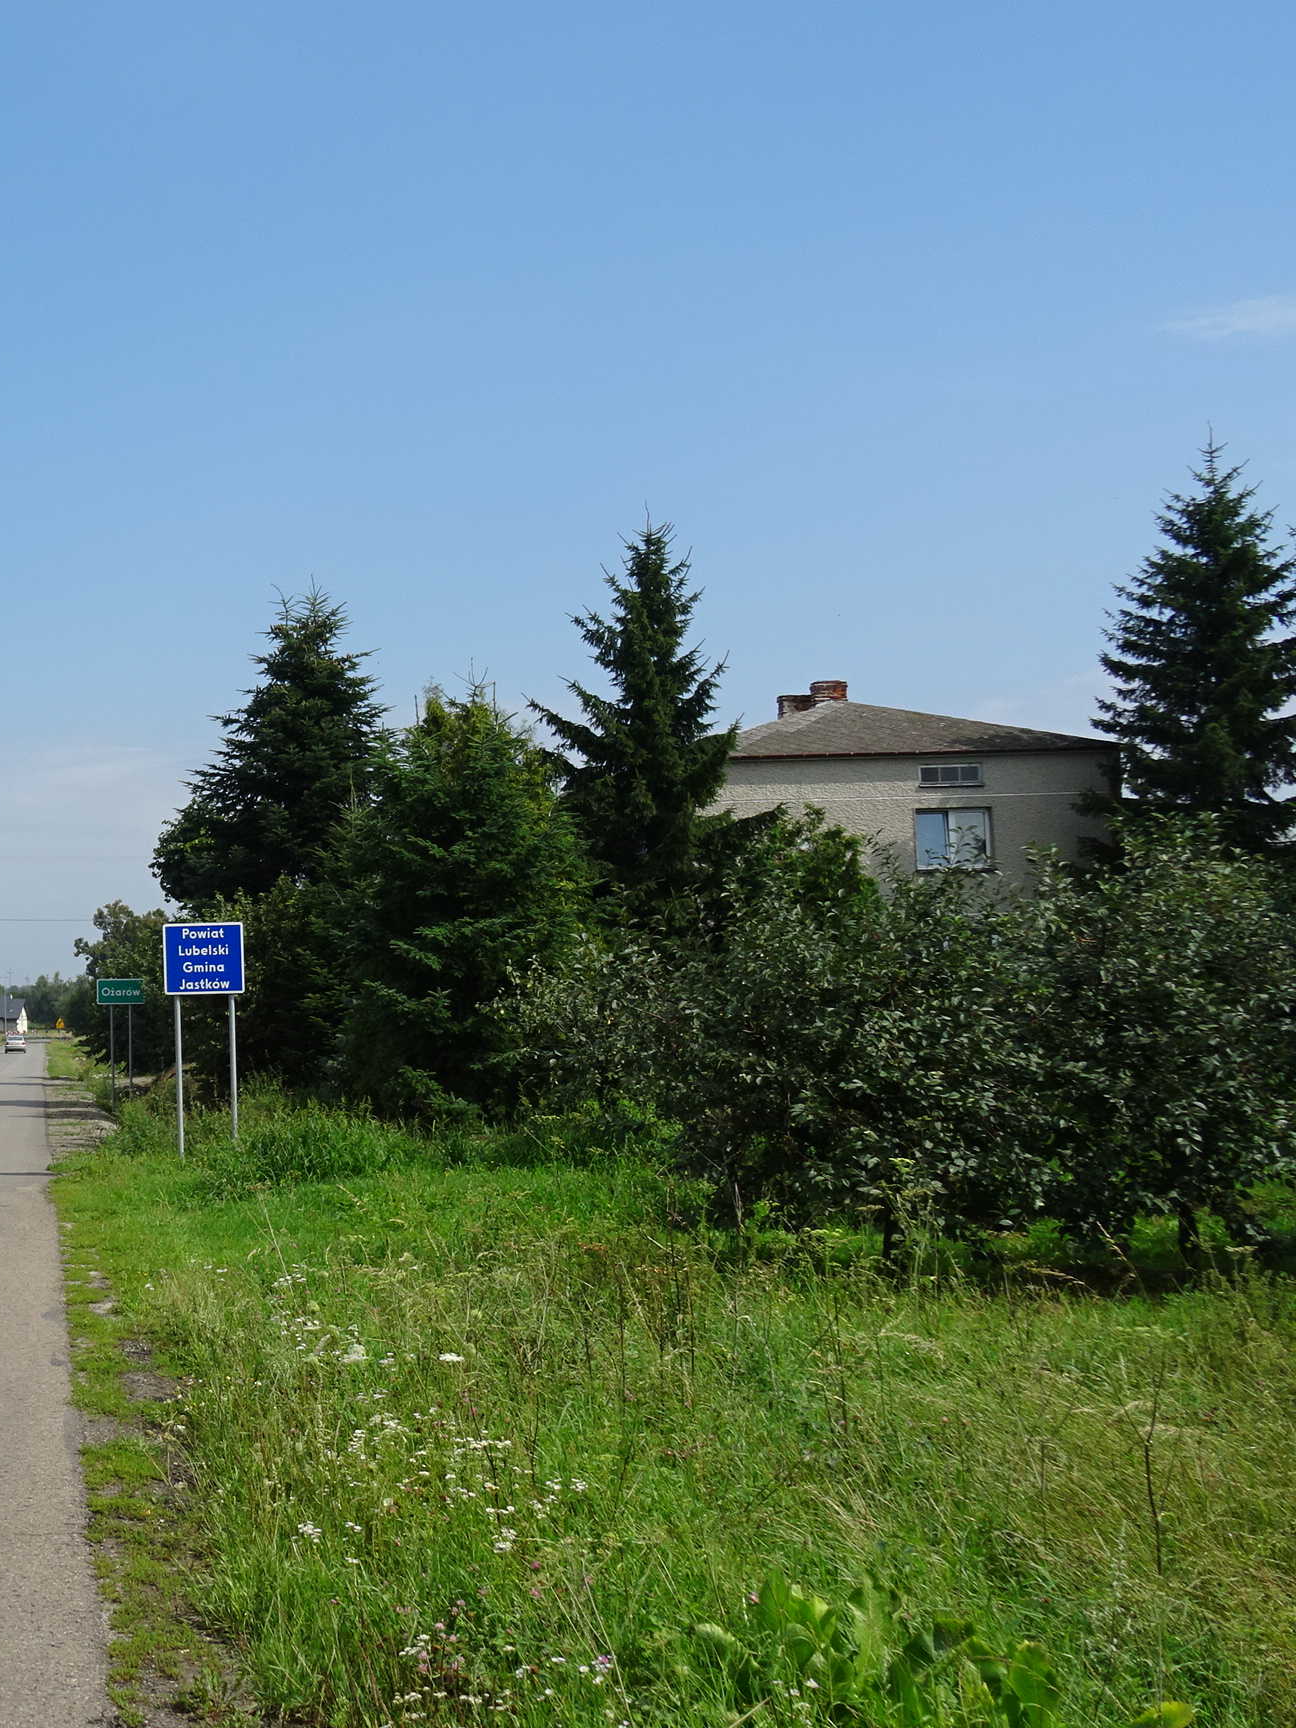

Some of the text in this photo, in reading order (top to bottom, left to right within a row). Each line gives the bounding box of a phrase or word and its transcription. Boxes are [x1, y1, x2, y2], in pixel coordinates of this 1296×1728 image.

[182, 928, 224, 939] Powiat
[178, 944, 229, 956] Lubelski
[182, 961, 225, 973] Gmina
[179, 978, 230, 990] Jastków
[101, 987, 141, 996] Ożarów
